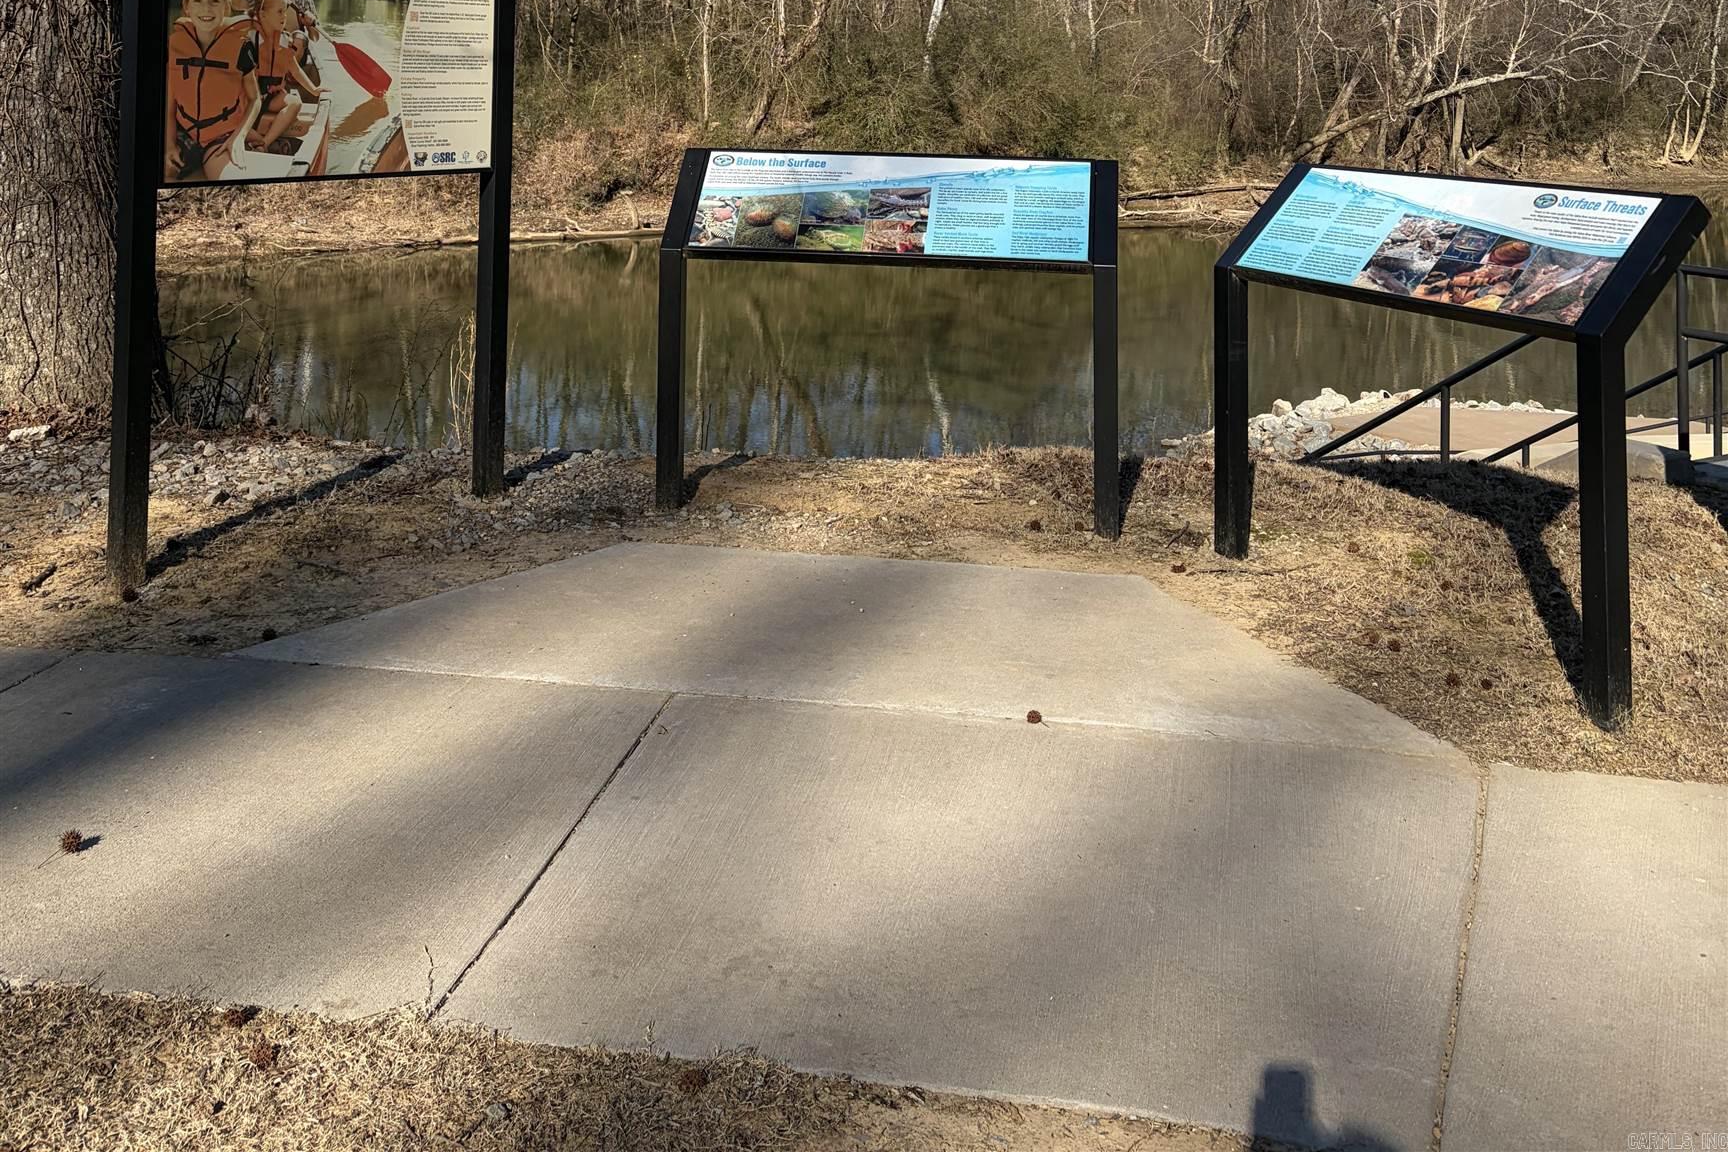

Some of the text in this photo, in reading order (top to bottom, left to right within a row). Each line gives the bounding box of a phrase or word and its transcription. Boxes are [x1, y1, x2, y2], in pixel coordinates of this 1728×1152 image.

[736, 156, 826, 169] Below the Surface
[1557, 196, 1648, 216] Surface Threats
